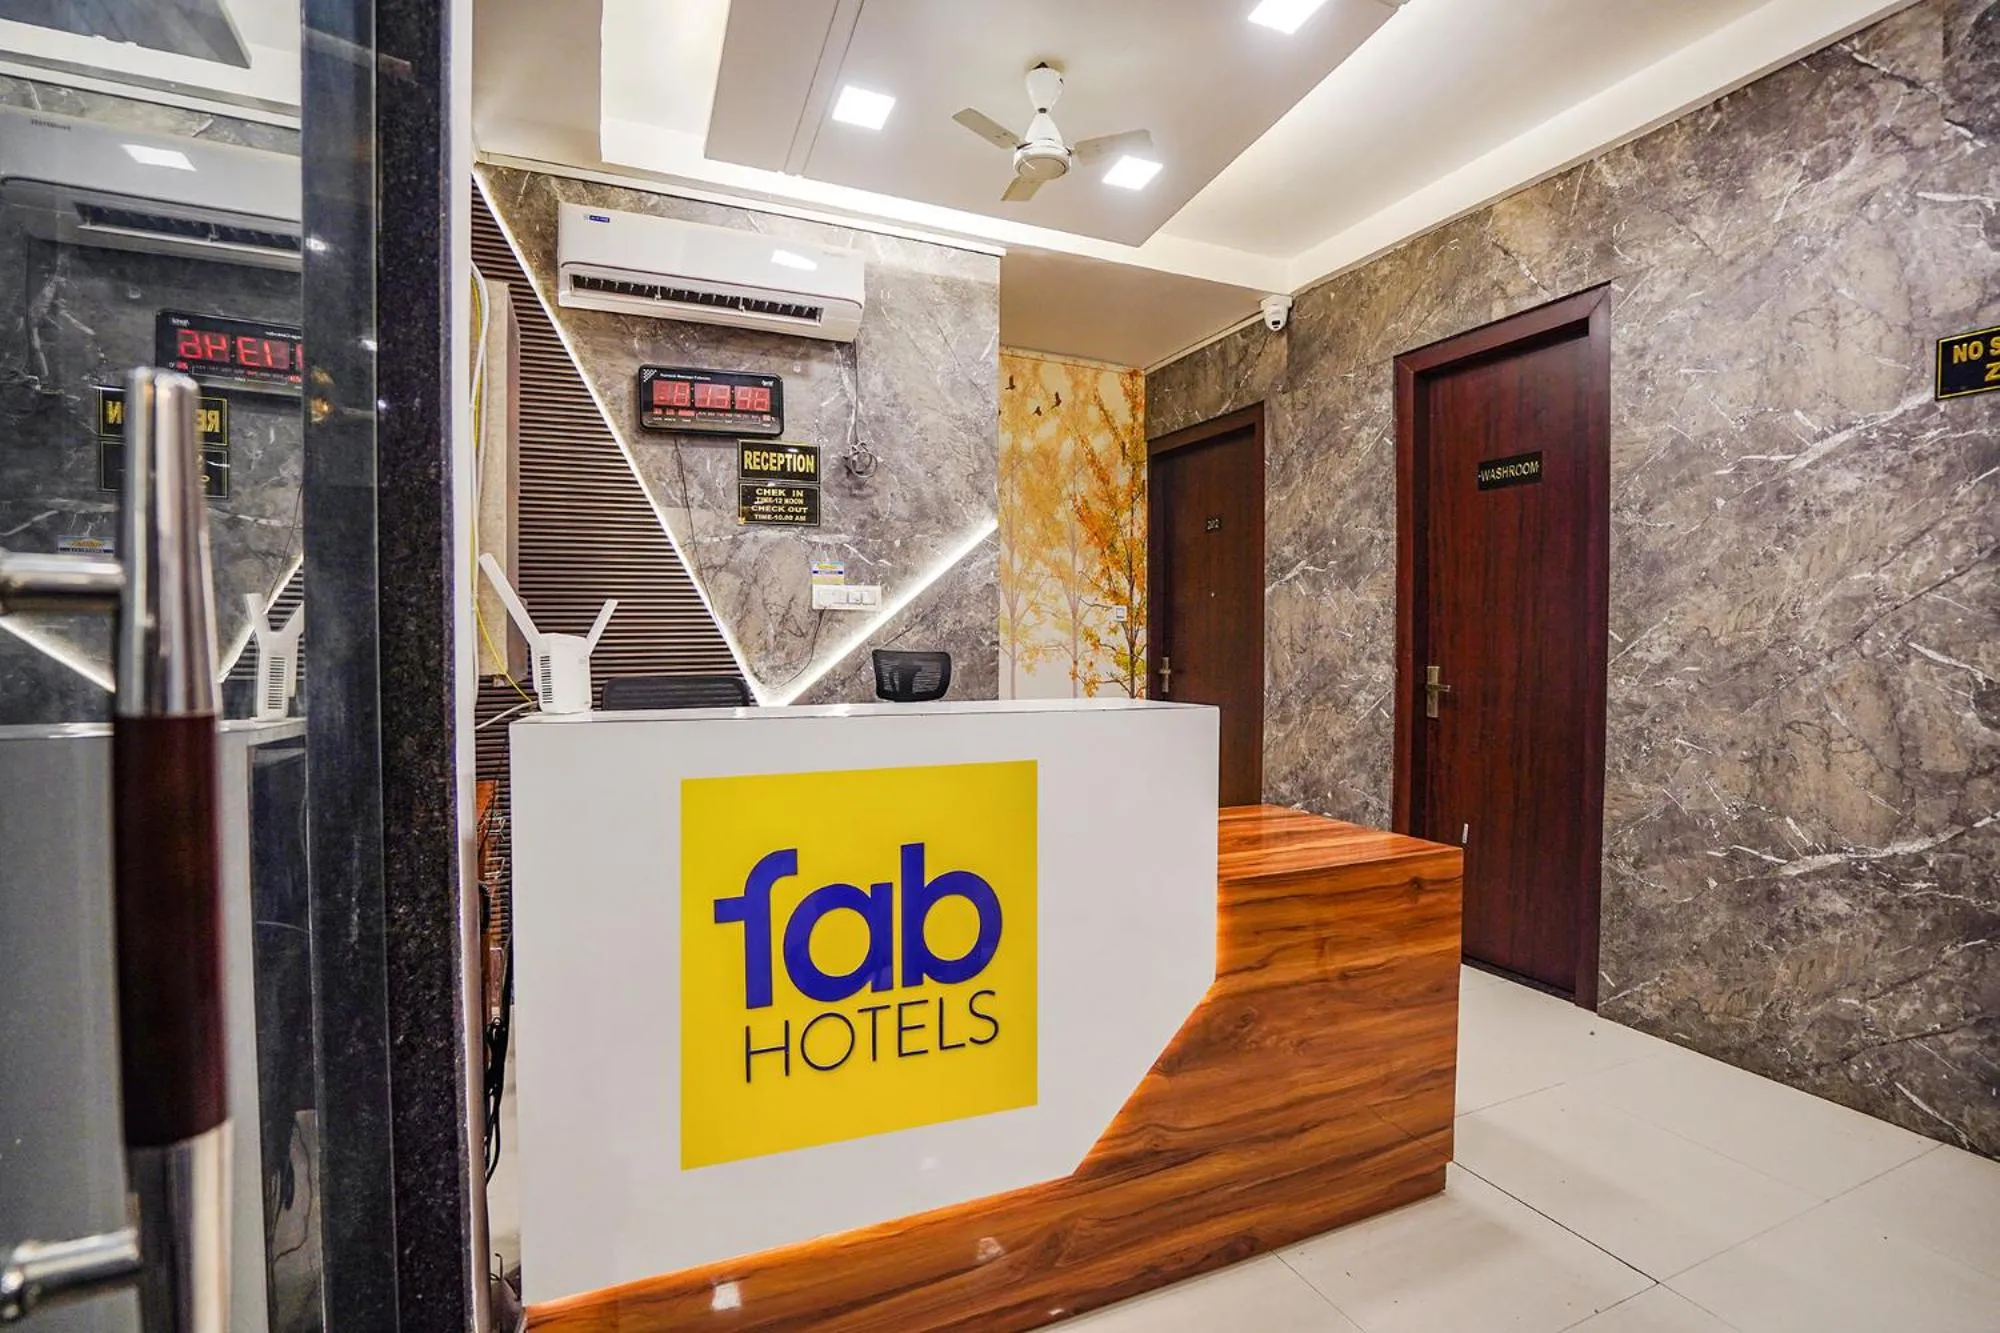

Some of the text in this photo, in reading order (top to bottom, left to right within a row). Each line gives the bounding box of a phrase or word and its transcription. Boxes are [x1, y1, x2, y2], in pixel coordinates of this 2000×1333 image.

[1953, 340, 1984, 364] NO
[743, 450, 815, 474] RECEPTION
[1480, 460, 1538, 482] WASHROOM
[755, 487, 804, 498] CHEK IN
[751, 505, 808, 514] CHECK OUT
[714, 842, 1003, 1010] fab
[745, 990, 1000, 1083] HOTELS
